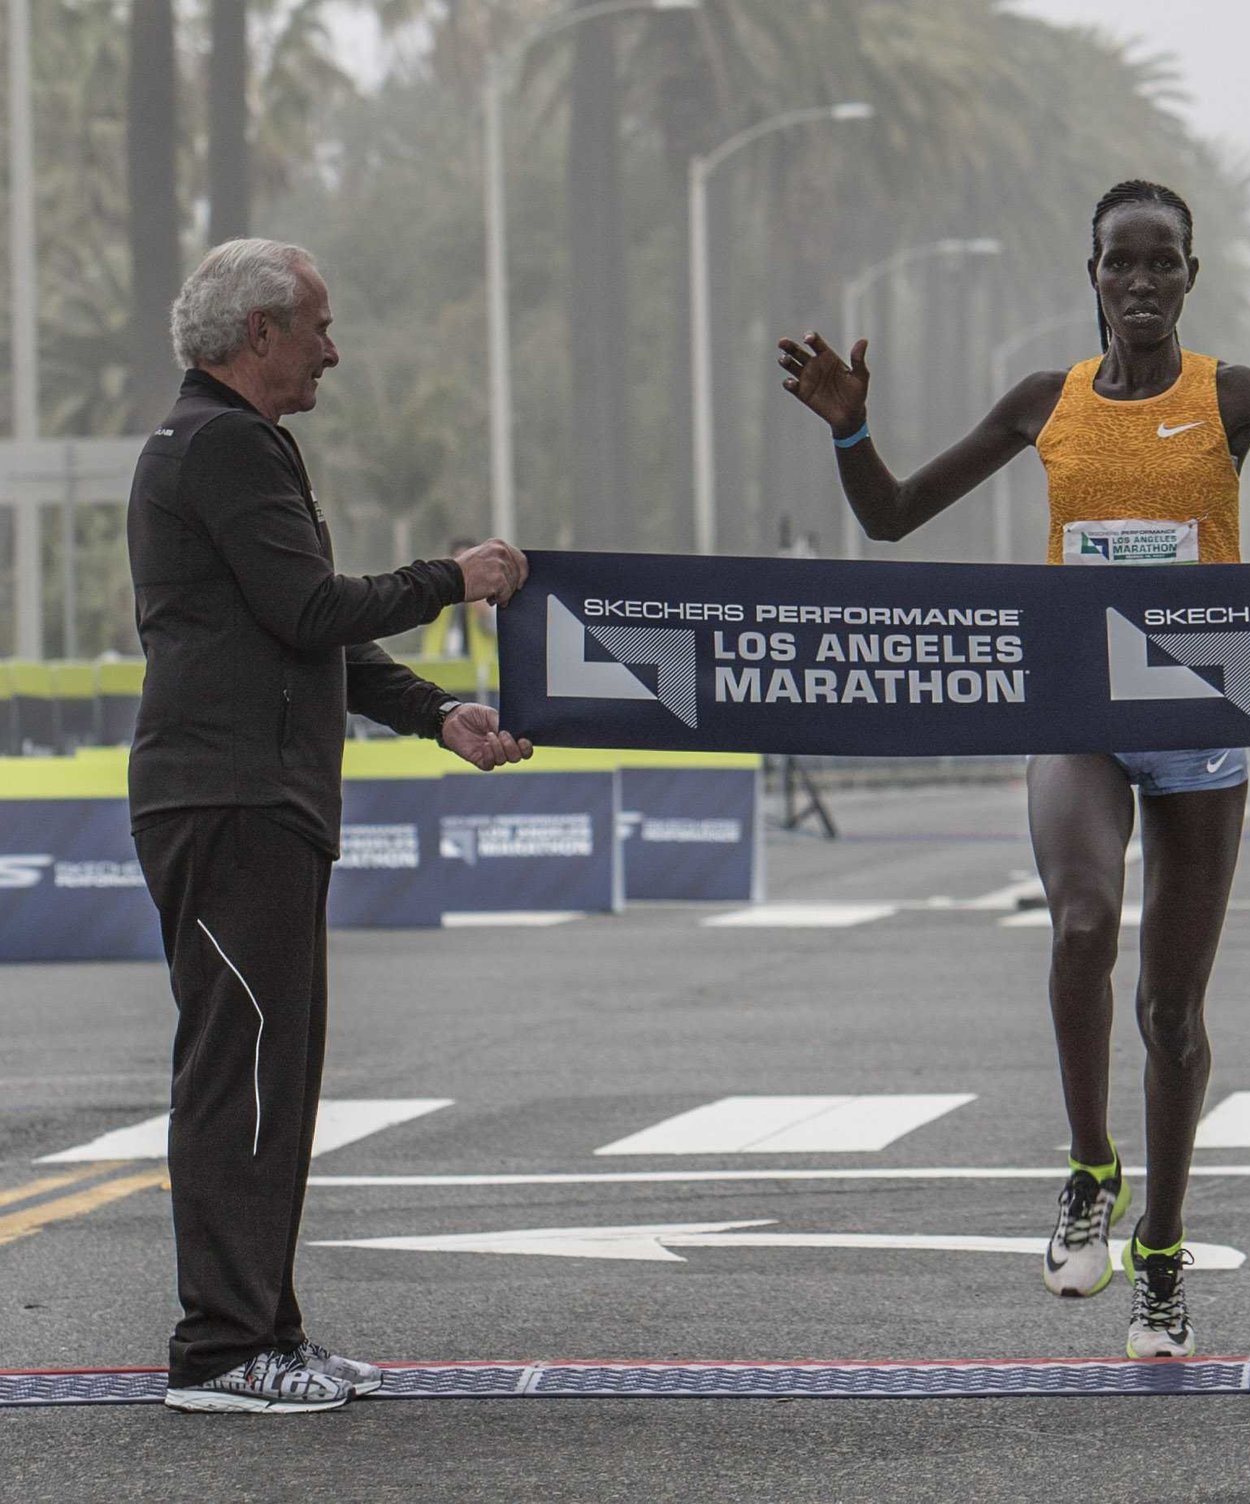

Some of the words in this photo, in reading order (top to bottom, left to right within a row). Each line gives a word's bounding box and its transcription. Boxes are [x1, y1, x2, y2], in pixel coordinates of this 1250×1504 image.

[1112, 543, 1177, 554] MARATHON
[1134, 535, 1177, 543] ANGELES
[584, 598, 744, 622] SKECHERS
[756, 604, 1020, 626] PERFORMANCE
[713, 630, 796, 661] LOS
[815, 633, 1023, 663] ANGELES
[714, 667, 1026, 704] MARATHON
